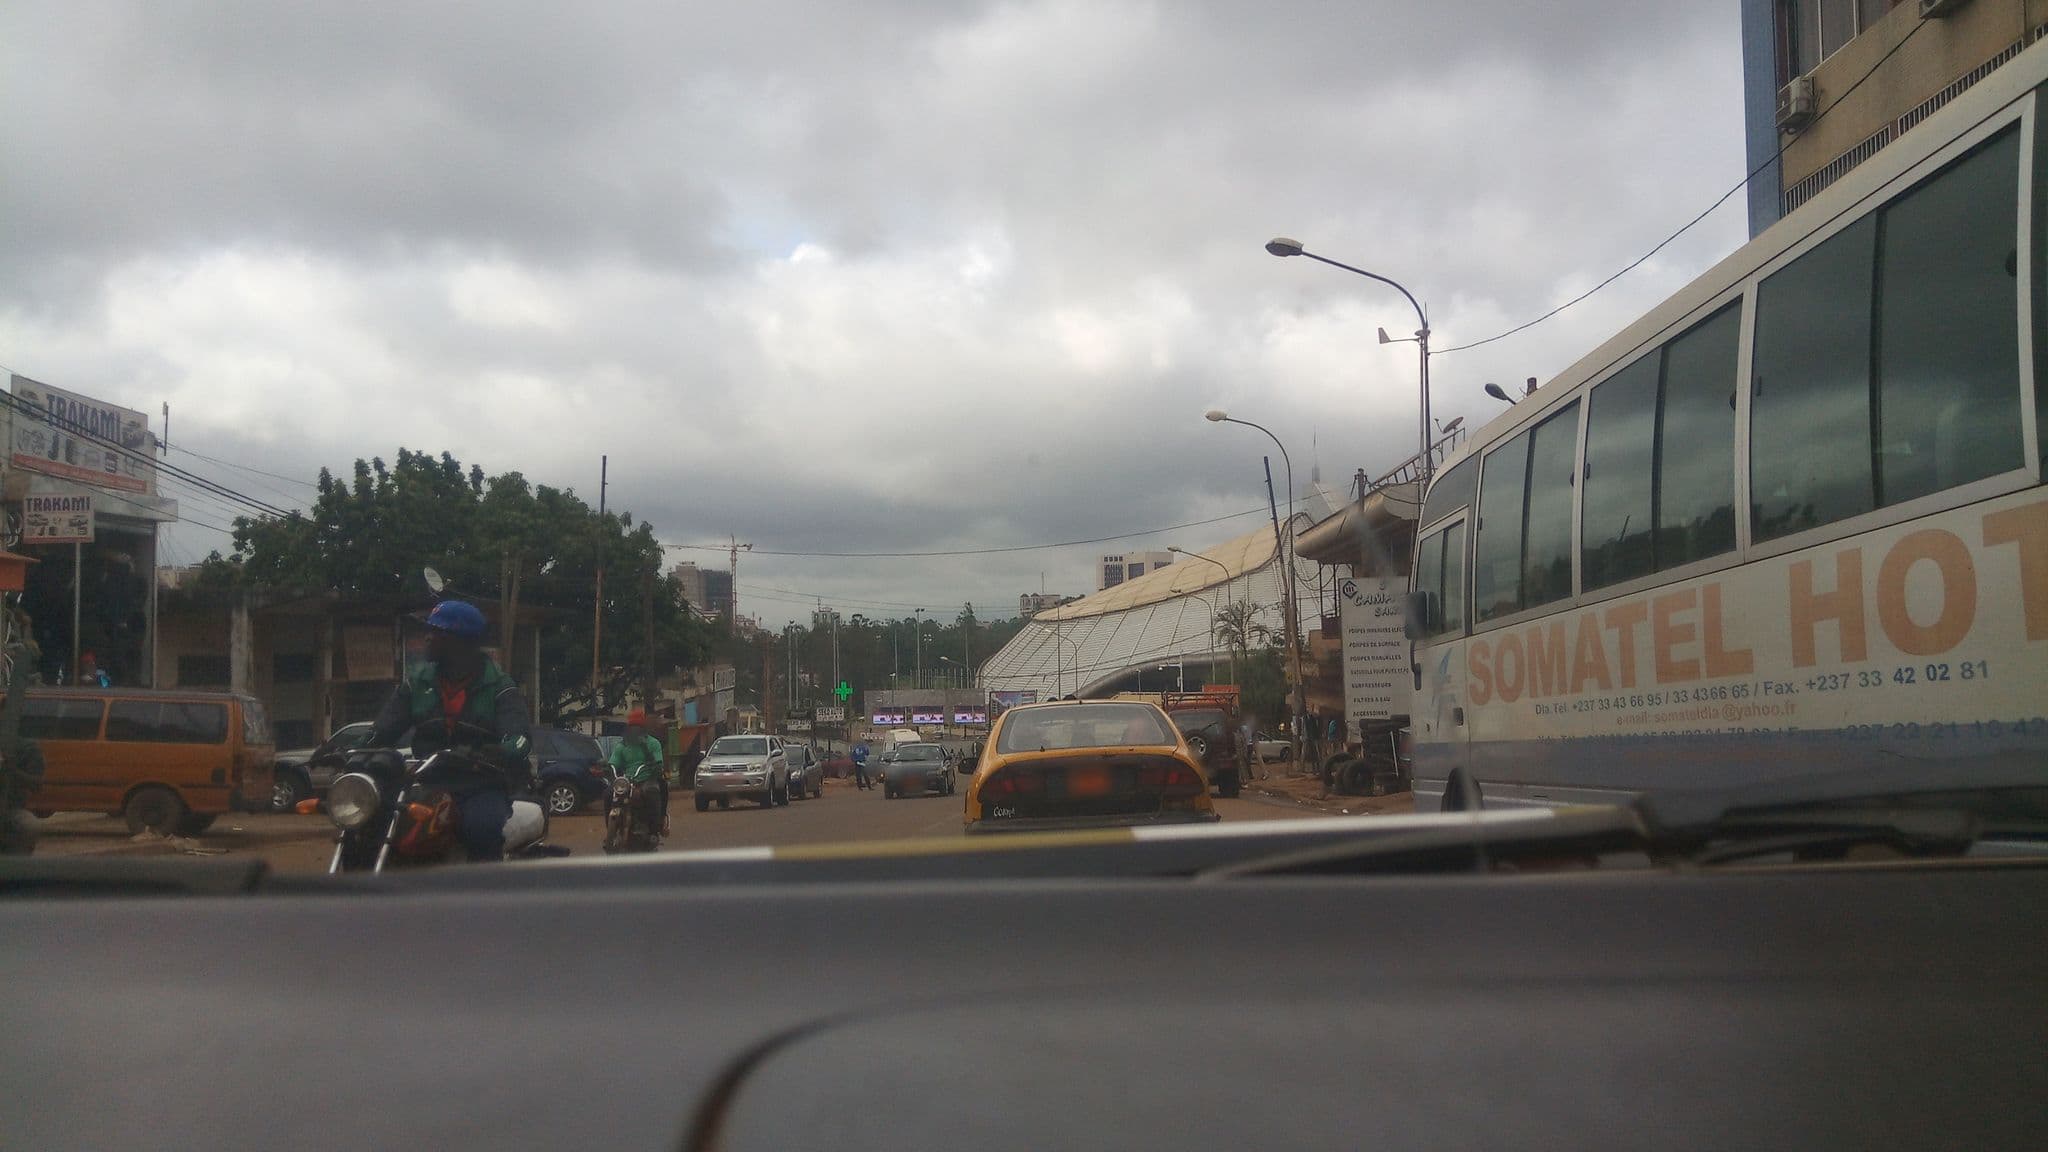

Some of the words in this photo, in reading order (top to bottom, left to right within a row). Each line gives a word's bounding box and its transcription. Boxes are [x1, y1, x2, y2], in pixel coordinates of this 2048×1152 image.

[47, 393, 121, 443] TRAKAMI
[26, 497, 91, 512] TRAKAMI
[1469, 583, 1754, 706] SOMATEL
[1789, 500, 2048, 668] HOT
[1598, 698, 1610, 710] 33
[1613, 696, 1627, 709] 43
[1630, 695, 1644, 707] 66
[1647, 693, 1662, 706] 95
[1673, 690, 1688, 703] 33
[1732, 683, 1749, 699] 65
[1763, 680, 1799, 696] Fax.
[1806, 673, 1850, 691] +237
[1858, 671, 1882, 687] 33
[1893, 667, 1915, 684] 42
[1926, 663, 1950, 681] 02
[1960, 660, 1989, 679] 81
